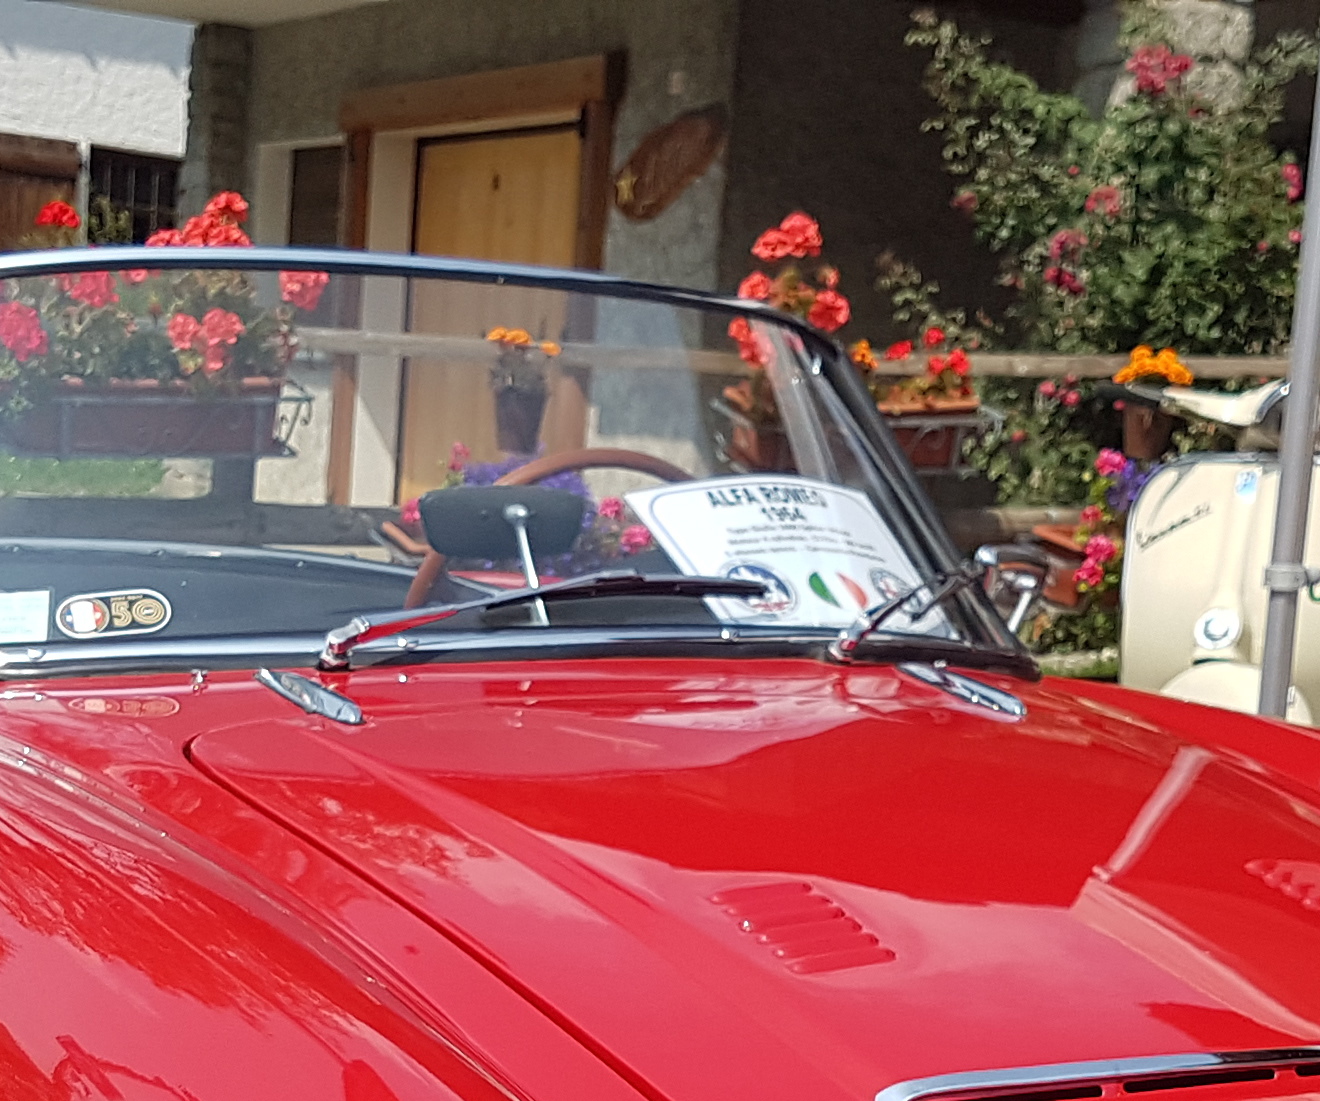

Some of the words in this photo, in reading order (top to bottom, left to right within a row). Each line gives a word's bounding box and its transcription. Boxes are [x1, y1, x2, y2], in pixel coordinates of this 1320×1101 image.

[707, 488, 757, 508] ALFA
[759, 487, 827, 507] ROMEO
[111, 600, 165, 628] 50
